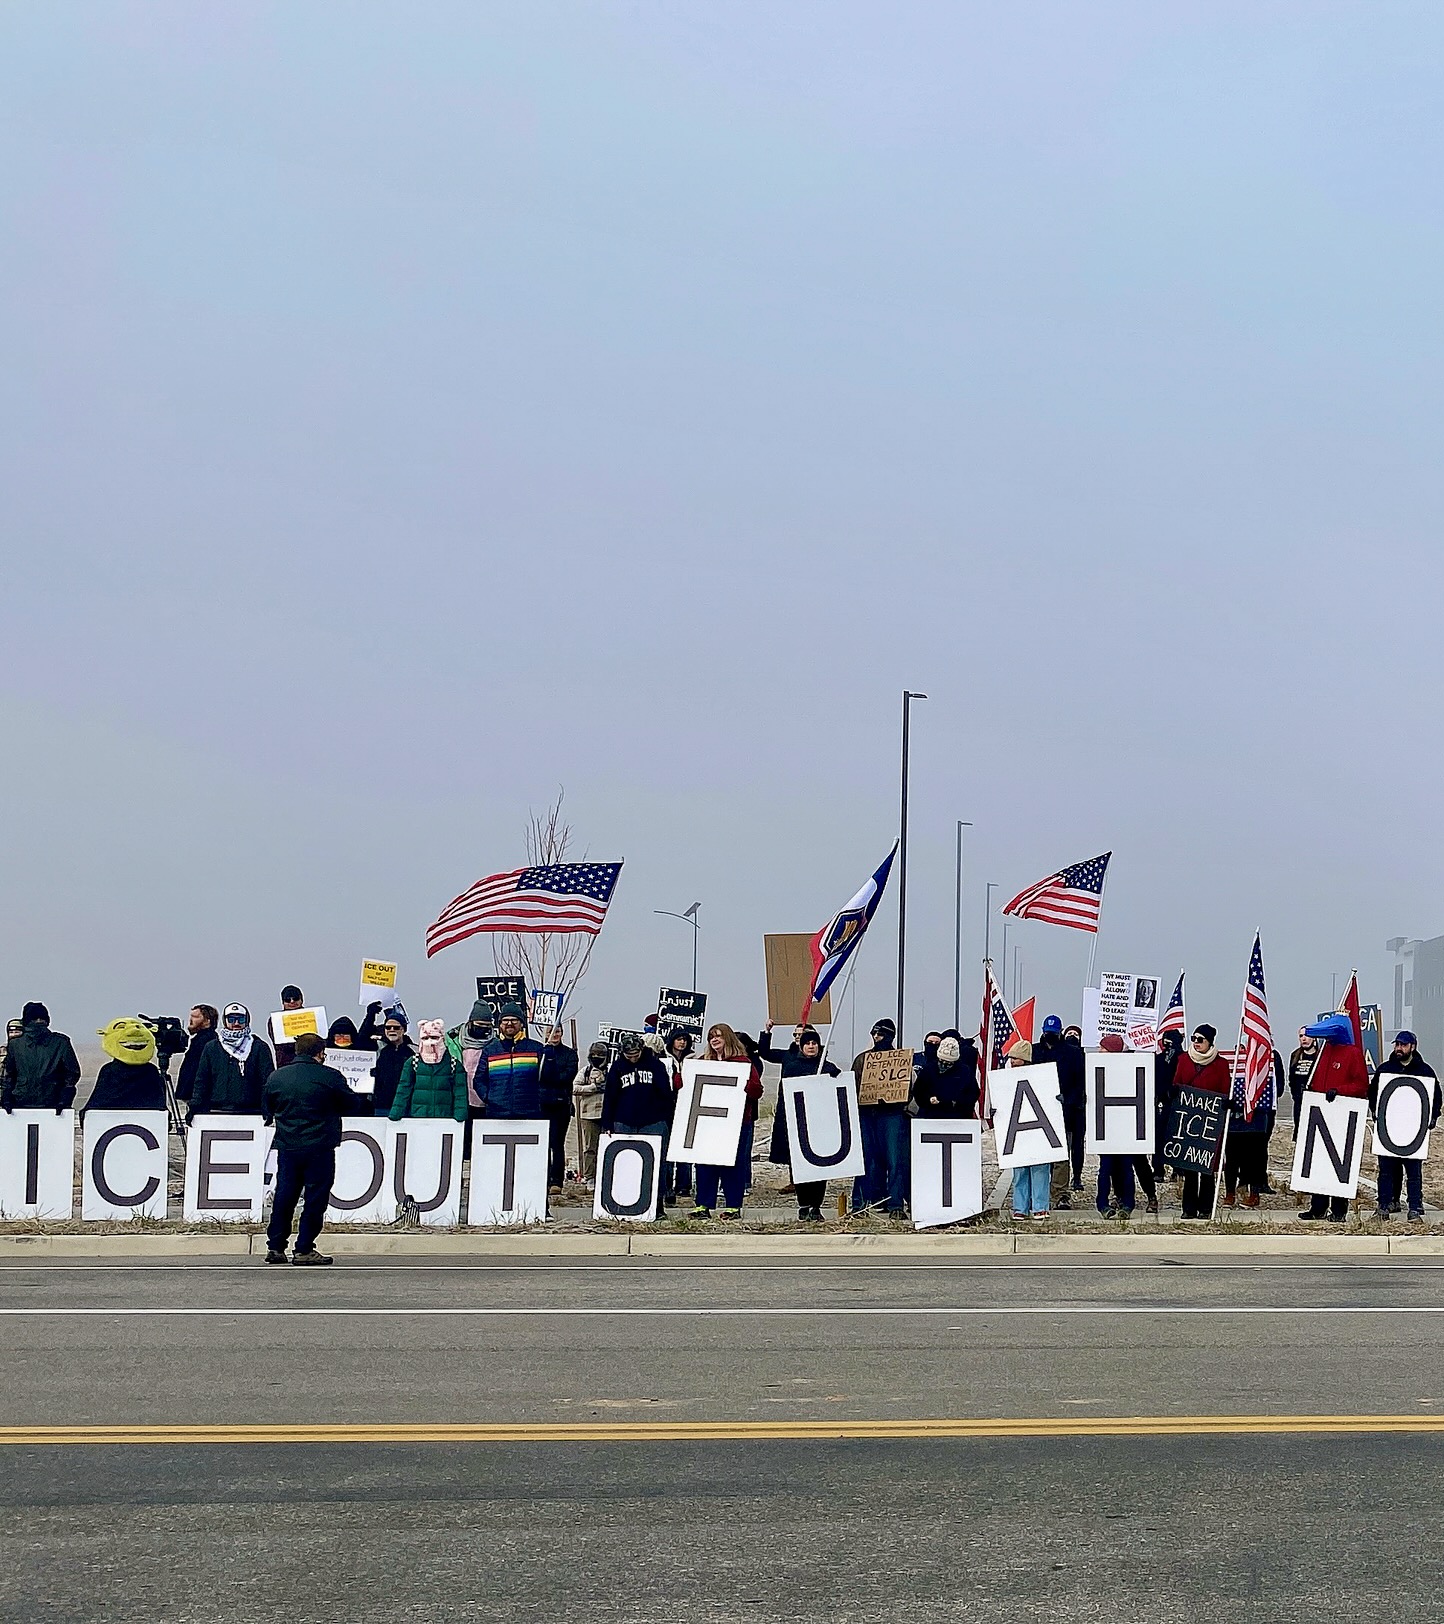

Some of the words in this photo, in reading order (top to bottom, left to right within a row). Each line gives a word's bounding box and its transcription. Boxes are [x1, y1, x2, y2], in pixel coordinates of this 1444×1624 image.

[480, 982, 518, 998] ICE
[537, 994, 556, 1009] ICE
[660, 988, 695, 1008] Injust
[536, 1006, 554, 1016] OUT
[1098, 1020, 1128, 1028] VIOLATION
[1128, 1026, 1153, 1038] NEVER
[866, 1052, 882, 1060] NO
[888, 1050, 904, 1058] ICE
[866, 1058, 910, 1069] DETENTION
[886, 1090, 907, 1102] GREAT
[1180, 1090, 1222, 1114] MAKE
[1172, 1110, 1218, 1141] ICE
[1164, 1142, 1182, 1158] GO
[1184, 1146, 1214, 1168] AWAY
[25, 1124, 254, 1210] ICE
